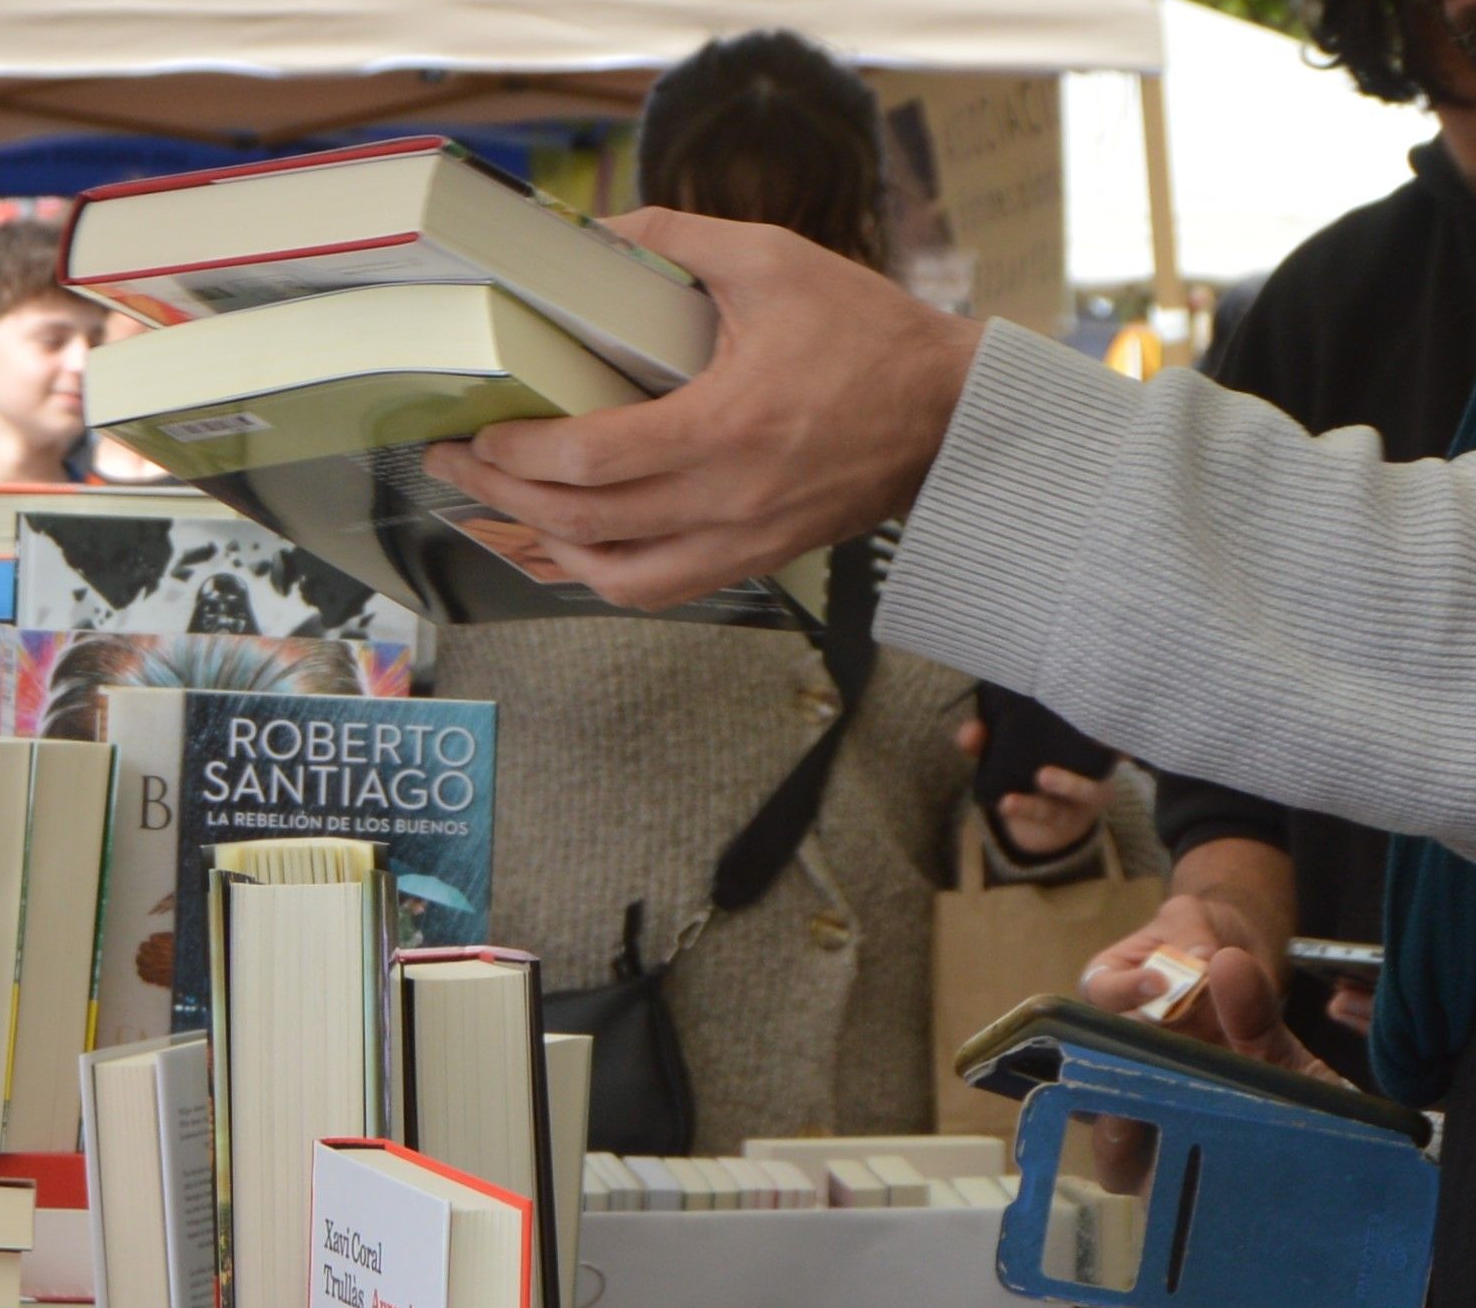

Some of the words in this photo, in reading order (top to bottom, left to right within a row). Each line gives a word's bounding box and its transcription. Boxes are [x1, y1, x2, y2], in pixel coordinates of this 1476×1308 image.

[228, 717, 476, 768] ROBERTO
[202, 760, 475, 812] SANTIAGO
[207, 810, 230, 827] LA
[233, 810, 318, 831] REBELIÓN
[326, 815, 351, 832] DE
[354, 817, 391, 834] LOS
[394, 819, 470, 836] BUENOS
[324, 1218, 350, 1260] Xavi
[351, 1232, 383, 1274] Coral
